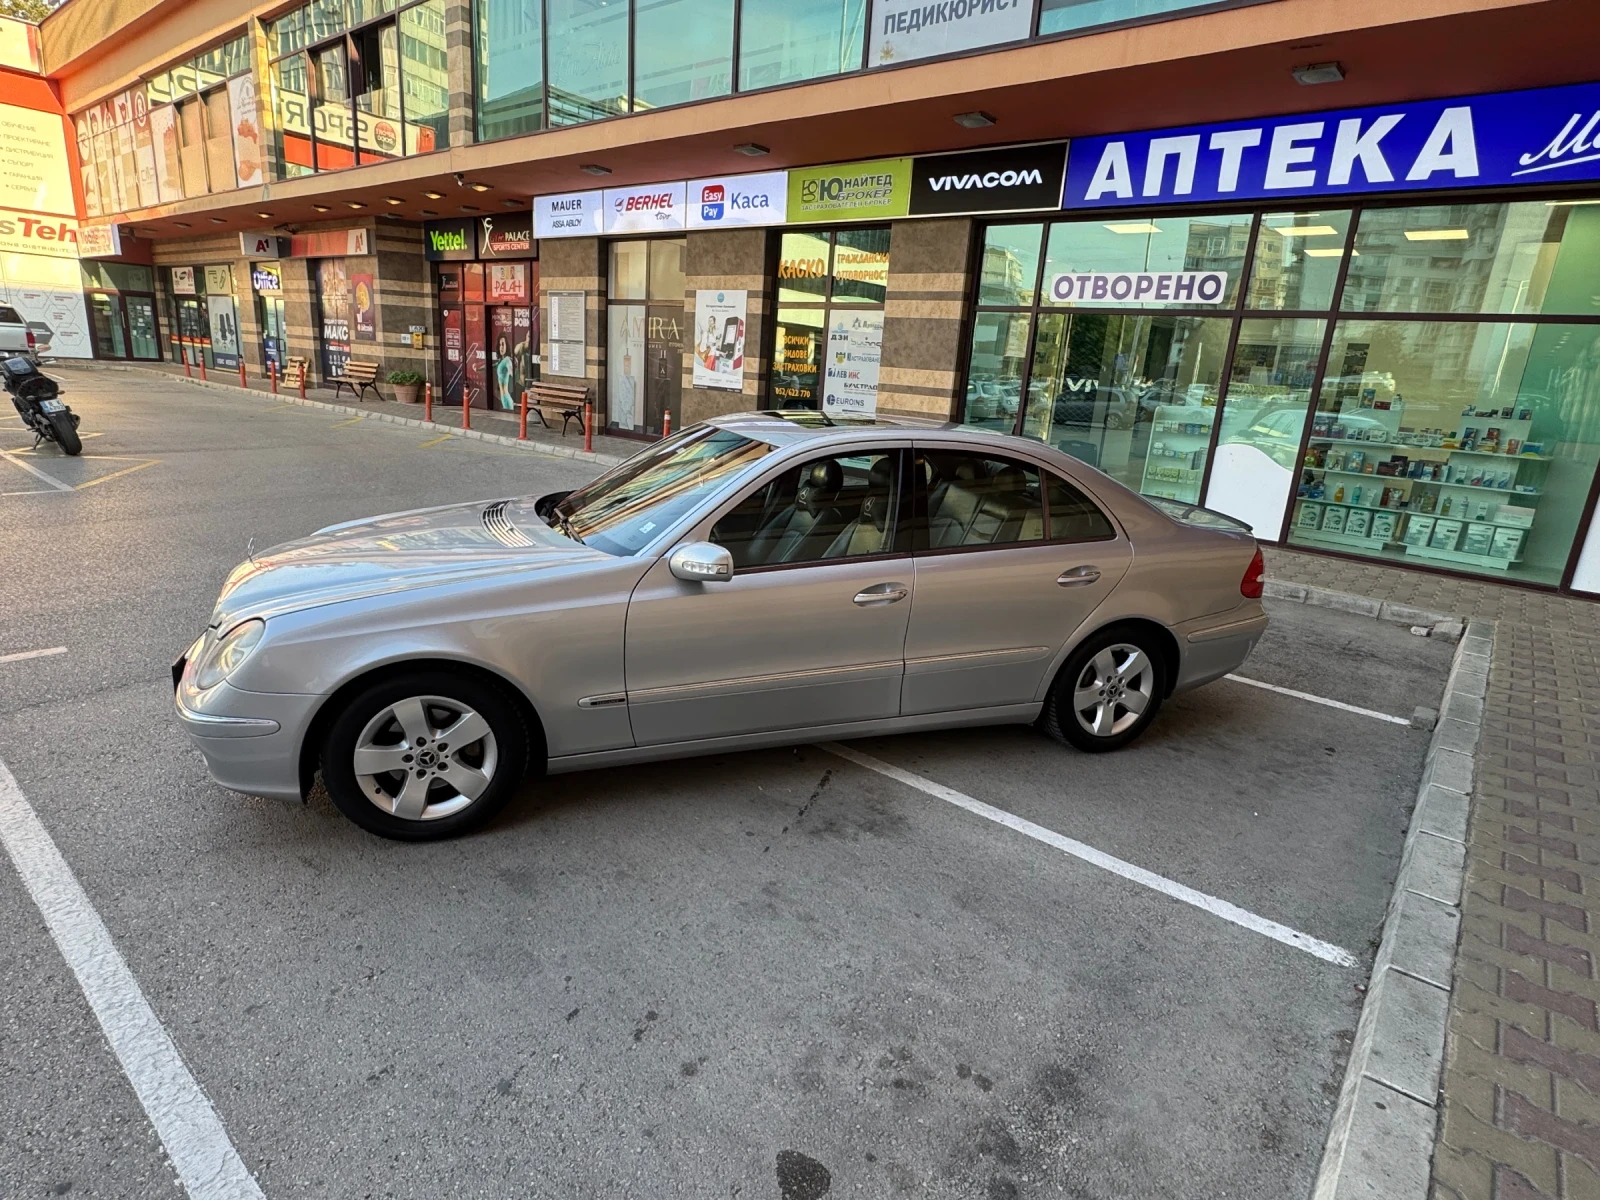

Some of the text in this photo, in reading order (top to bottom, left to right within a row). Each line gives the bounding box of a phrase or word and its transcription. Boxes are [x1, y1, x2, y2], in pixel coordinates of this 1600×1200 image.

[1084, 106, 1479, 200] АПТЕКА
[929, 169, 1042, 191] VIVACOM
[820, 174, 892, 201] ЮНАЙТЕД
[704, 189, 723, 202] Easy
[837, 188, 892, 201] БРОКЕР
[551, 199, 582, 212] MAUER
[625, 193, 674, 212] BERHEL
[703, 206, 718, 218] Pay
[552, 218, 582, 228] ASSA ABLOY
[505, 231, 530, 241] PALACE
[256, 239, 269, 252] A1
[493, 242, 530, 251] SPORTS CENTER
[837, 252, 890, 264] ГРАЖДАНСКА
[778, 258, 825, 279] КАСКО
[1054, 274, 1222, 300] ОТВОРЕНО
[324, 325, 349, 340] МАКС
[783, 335, 809, 345] ВСИЧКИ
[783, 349, 808, 359] ВИДОВЕ
[773, 362, 817, 373] ЗАСТРАХОВКИ
[836, 370, 860, 380] ЛЕВ ИНС
[775, 387, 811, 398] 052/622 770
[836, 397, 865, 407] EUROINS
